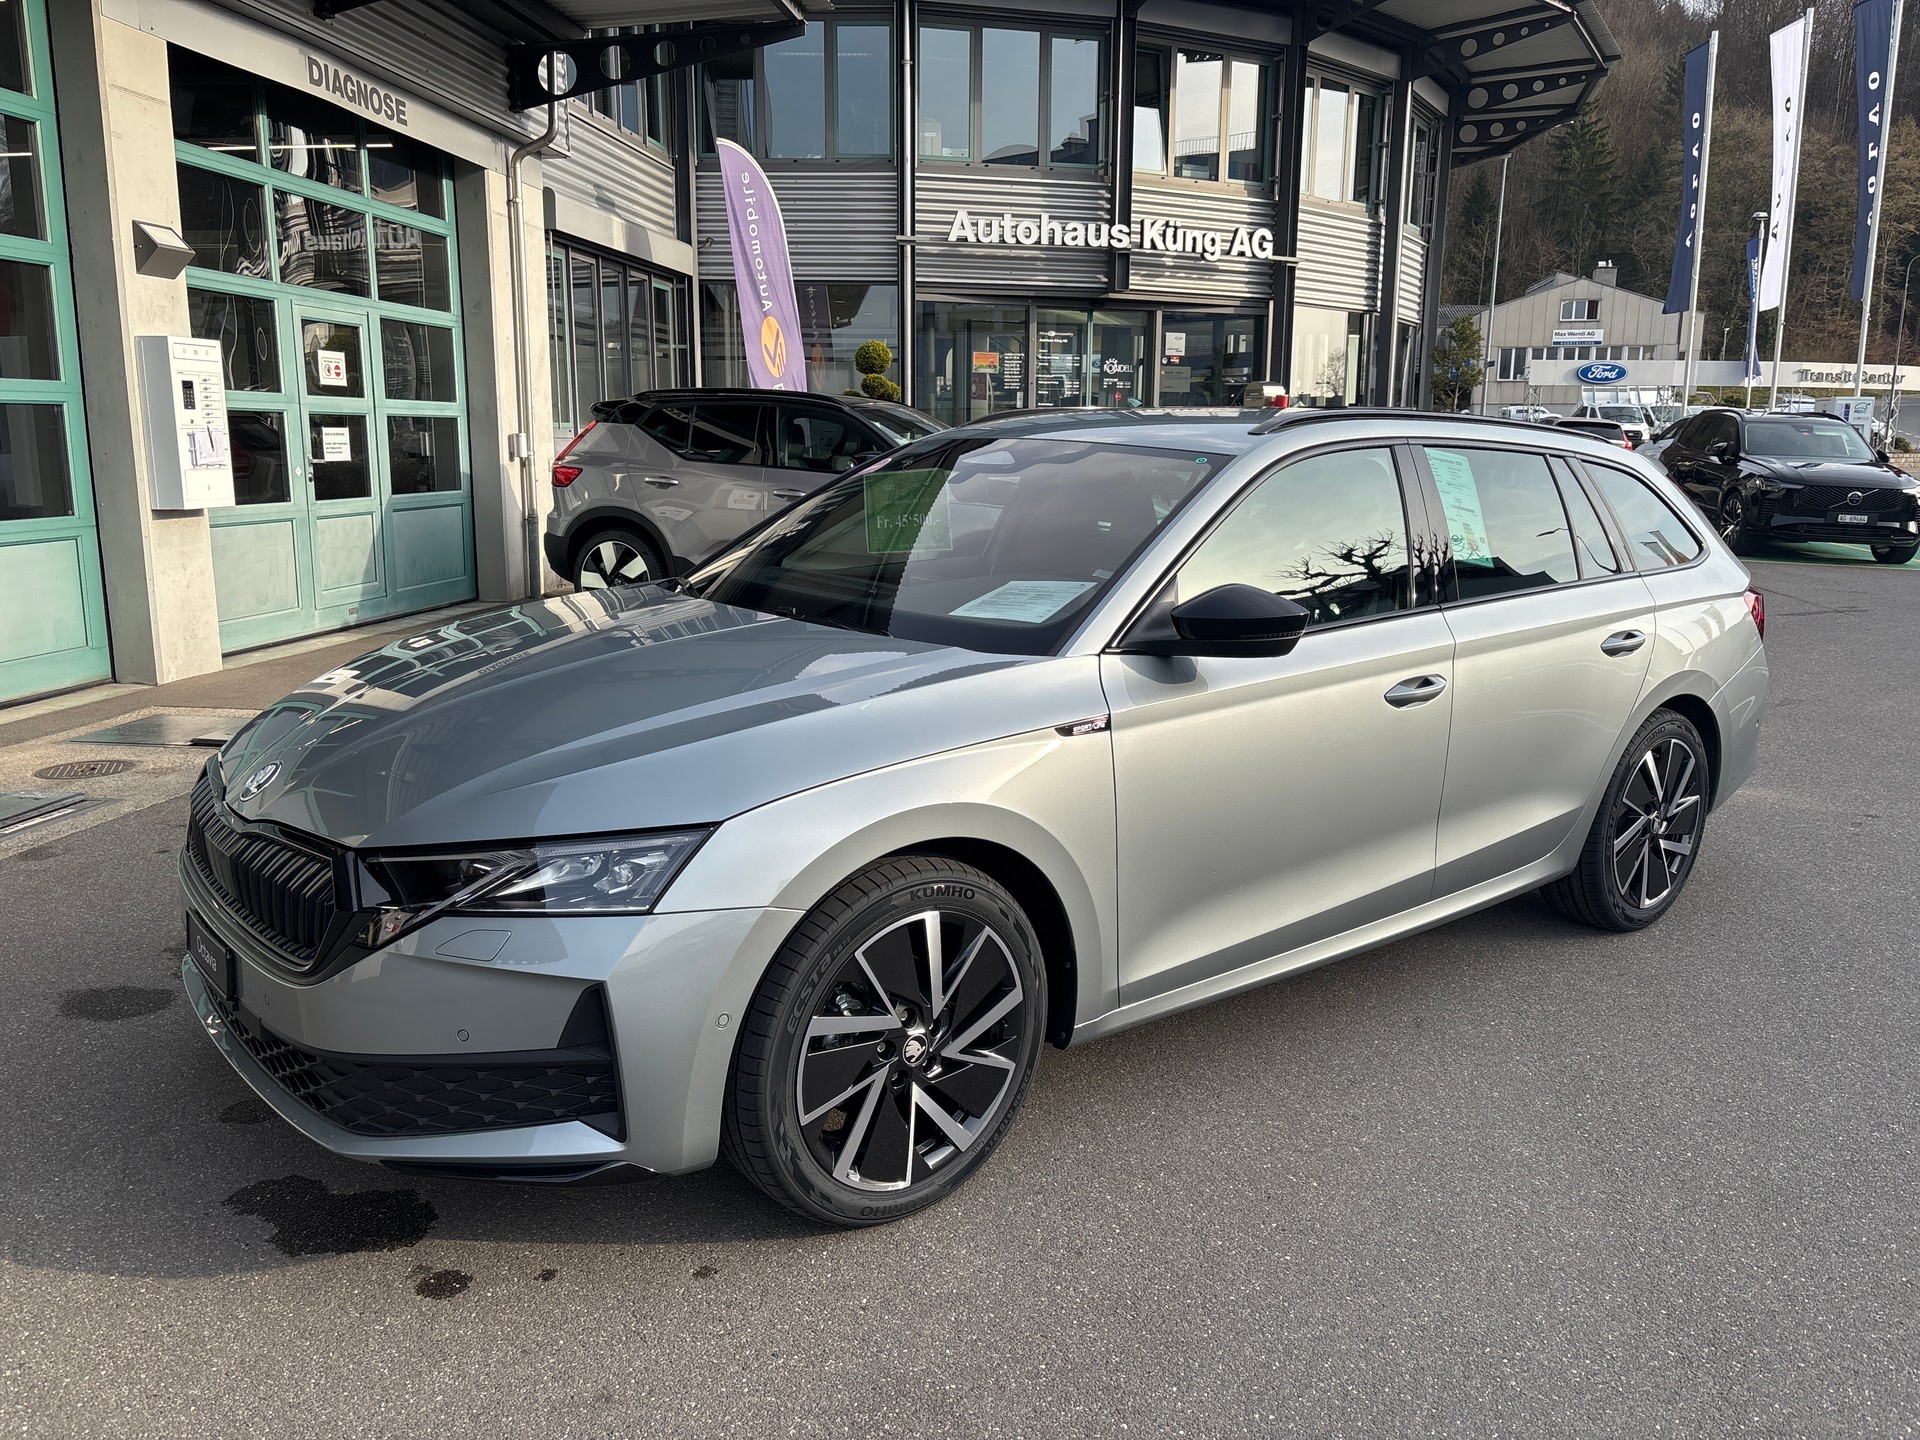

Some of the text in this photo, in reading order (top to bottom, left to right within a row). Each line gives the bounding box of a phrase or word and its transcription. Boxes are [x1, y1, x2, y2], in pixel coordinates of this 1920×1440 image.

[307, 56, 407, 127] DIAGNOSE
[947, 209, 1274, 261] Autohaus Küng AG
[1587, 365, 1619, 379] Ford
[1801, 369, 1852, 383] Transit
[876, 516, 892, 528] Fr.
[909, 885, 976, 901] KUMHO
[196, 935, 217, 972] Octavia
[859, 1192, 930, 1218] KUMHO
